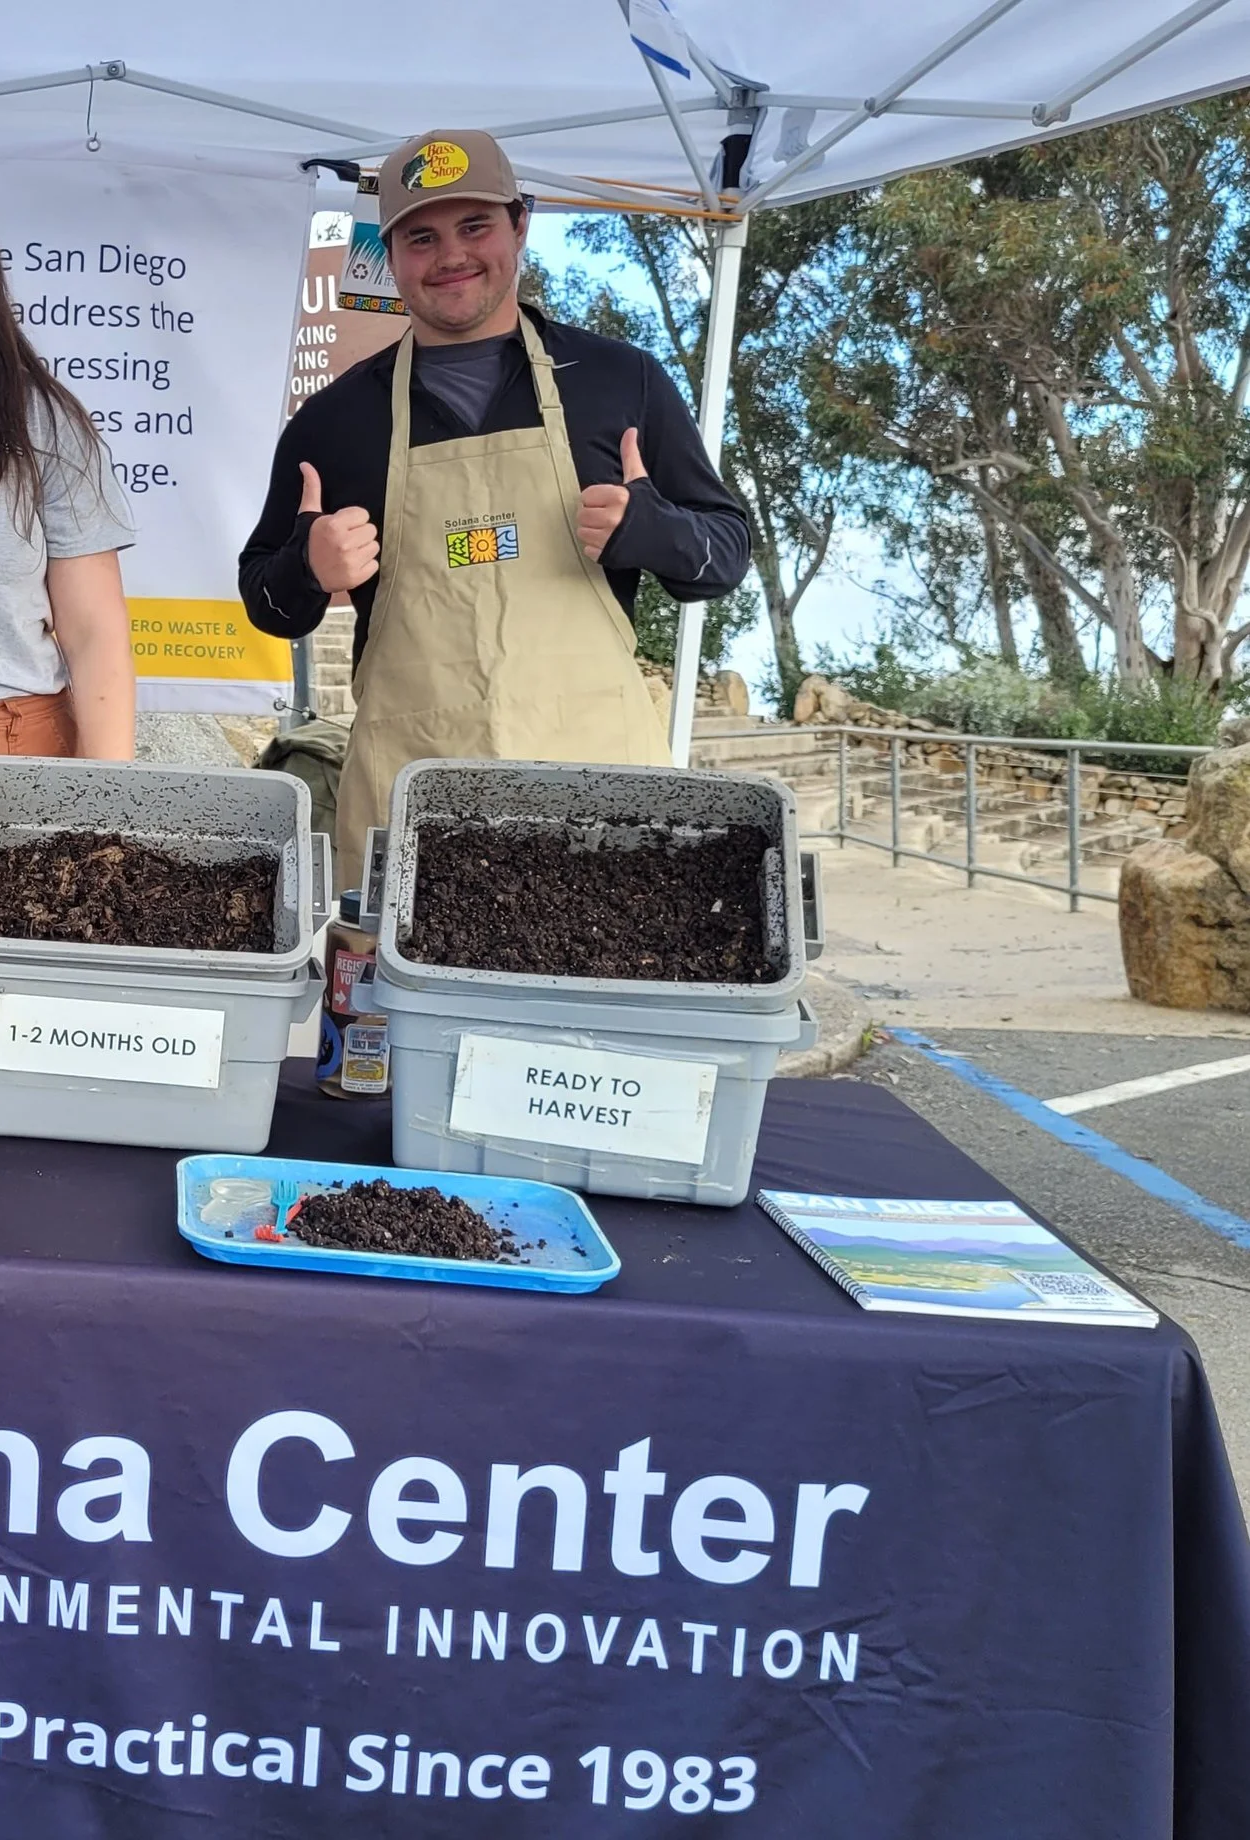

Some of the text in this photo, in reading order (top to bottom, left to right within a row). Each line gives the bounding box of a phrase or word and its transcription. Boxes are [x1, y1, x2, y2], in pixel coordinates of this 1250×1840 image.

[427, 144, 455, 158] Bass
[429, 156, 449, 168] Pro
[430, 166, 464, 179] Shops
[25, 242, 85, 273] San
[99, 244, 186, 286] Diego
[302, 275, 344, 314] UL
[150, 301, 194, 333] the
[296, 324, 337, 346] KING
[294, 350, 329, 370] ING
[90, 406, 193, 435] es and
[112, 462, 178, 493] nge.
[444, 518, 479, 528] Solana
[483, 512, 515, 523] Center
[131, 619, 237, 636] ERO WASTE &
[163, 644, 245, 659] RECOVERY
[340, 971, 356, 986] VOT
[9, 1025, 196, 1056] 1-2 MONTHS OLD
[526, 1067, 641, 1097] READY TO
[528, 1097, 631, 1127] HARVEST
[773, 1192, 867, 1211] SAN
[875, 1200, 1018, 1216] DIEGO
[226, 1410, 870, 1588] Center
[387, 1604, 859, 1682] INNOVATION
[345, 1733, 551, 1800] Since
[578, 1744, 757, 1815] 1983
